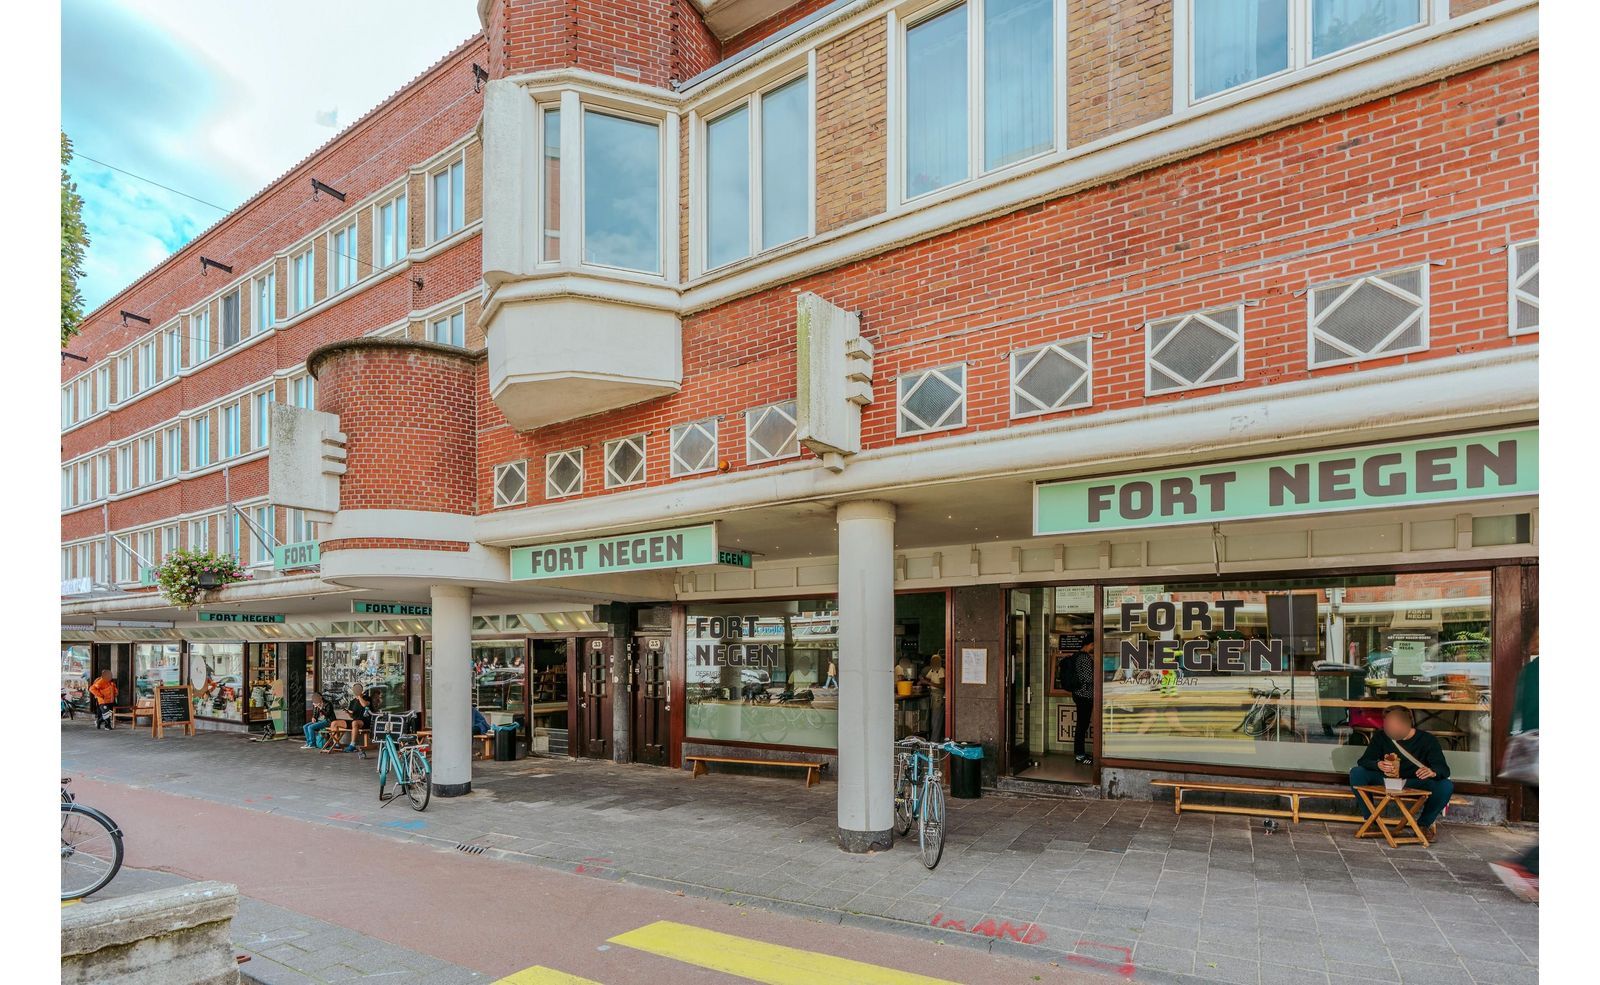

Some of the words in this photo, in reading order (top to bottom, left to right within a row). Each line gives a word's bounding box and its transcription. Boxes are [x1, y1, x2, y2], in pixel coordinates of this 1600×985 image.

[1087, 470, 1237, 523] FORT
[1268, 439, 1518, 507] NEGEN
[284, 544, 314, 565] FORT
[531, 545, 588, 574] FORT
[598, 533, 684, 568] NEGEN
[719, 551, 744, 566] EGEN
[209, 613, 238, 622] FORT
[242, 615, 276, 623] NEGEN
[365, 603, 396, 614] FORT
[1120, 600, 1245, 633] FORT
[695, 615, 760, 639] FORT
[322, 650, 349, 666] FORT
[695, 643, 779, 667] NEGEN
[1120, 638, 1283, 673] NEGEN
